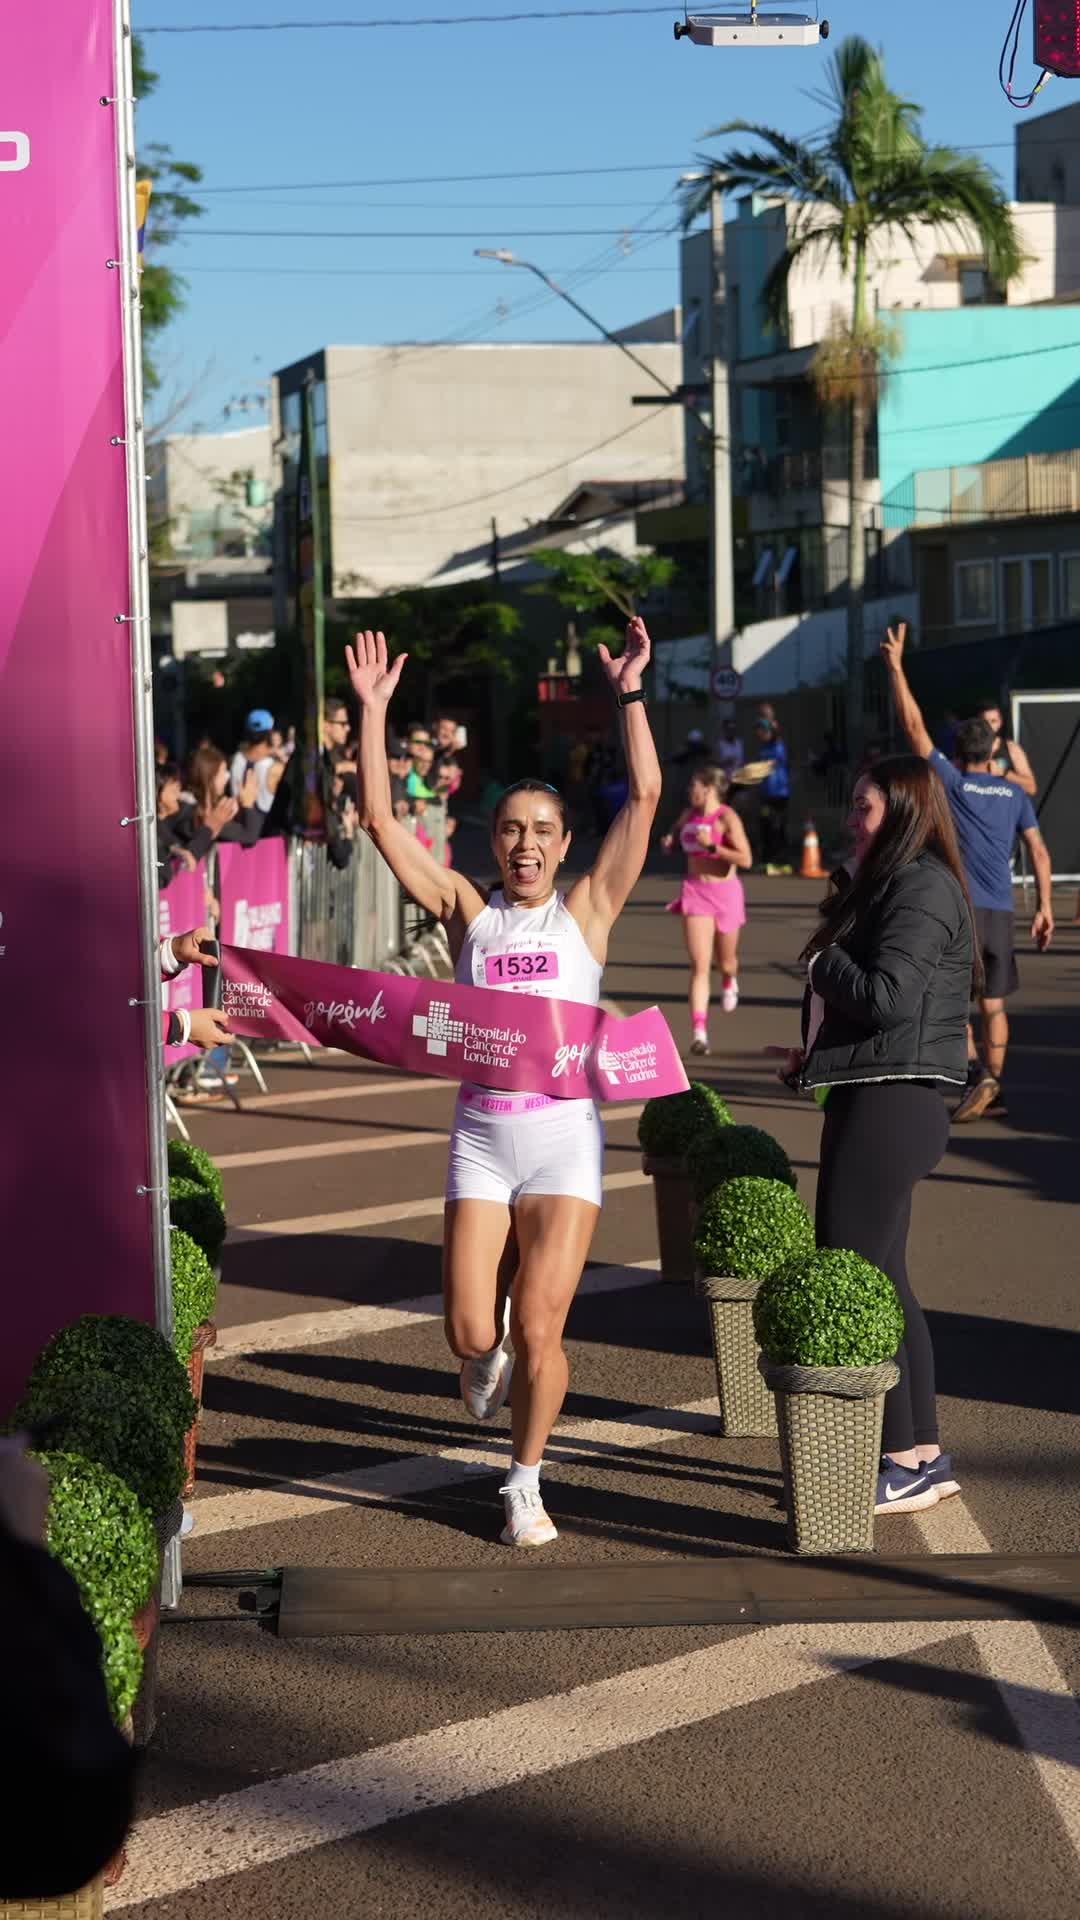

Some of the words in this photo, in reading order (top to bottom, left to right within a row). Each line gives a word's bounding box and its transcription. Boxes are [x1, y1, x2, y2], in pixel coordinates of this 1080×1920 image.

[494, 955, 548, 977] 1532
[221, 979, 264, 996] Hospital
[221, 991, 258, 1006] Câncer
[257, 995, 272, 1007] de
[464, 1022, 510, 1042] Hospital
[510, 1027, 527, 1045] do
[464, 1036, 503, 1054] Câncer
[502, 1041, 518, 1057] de
